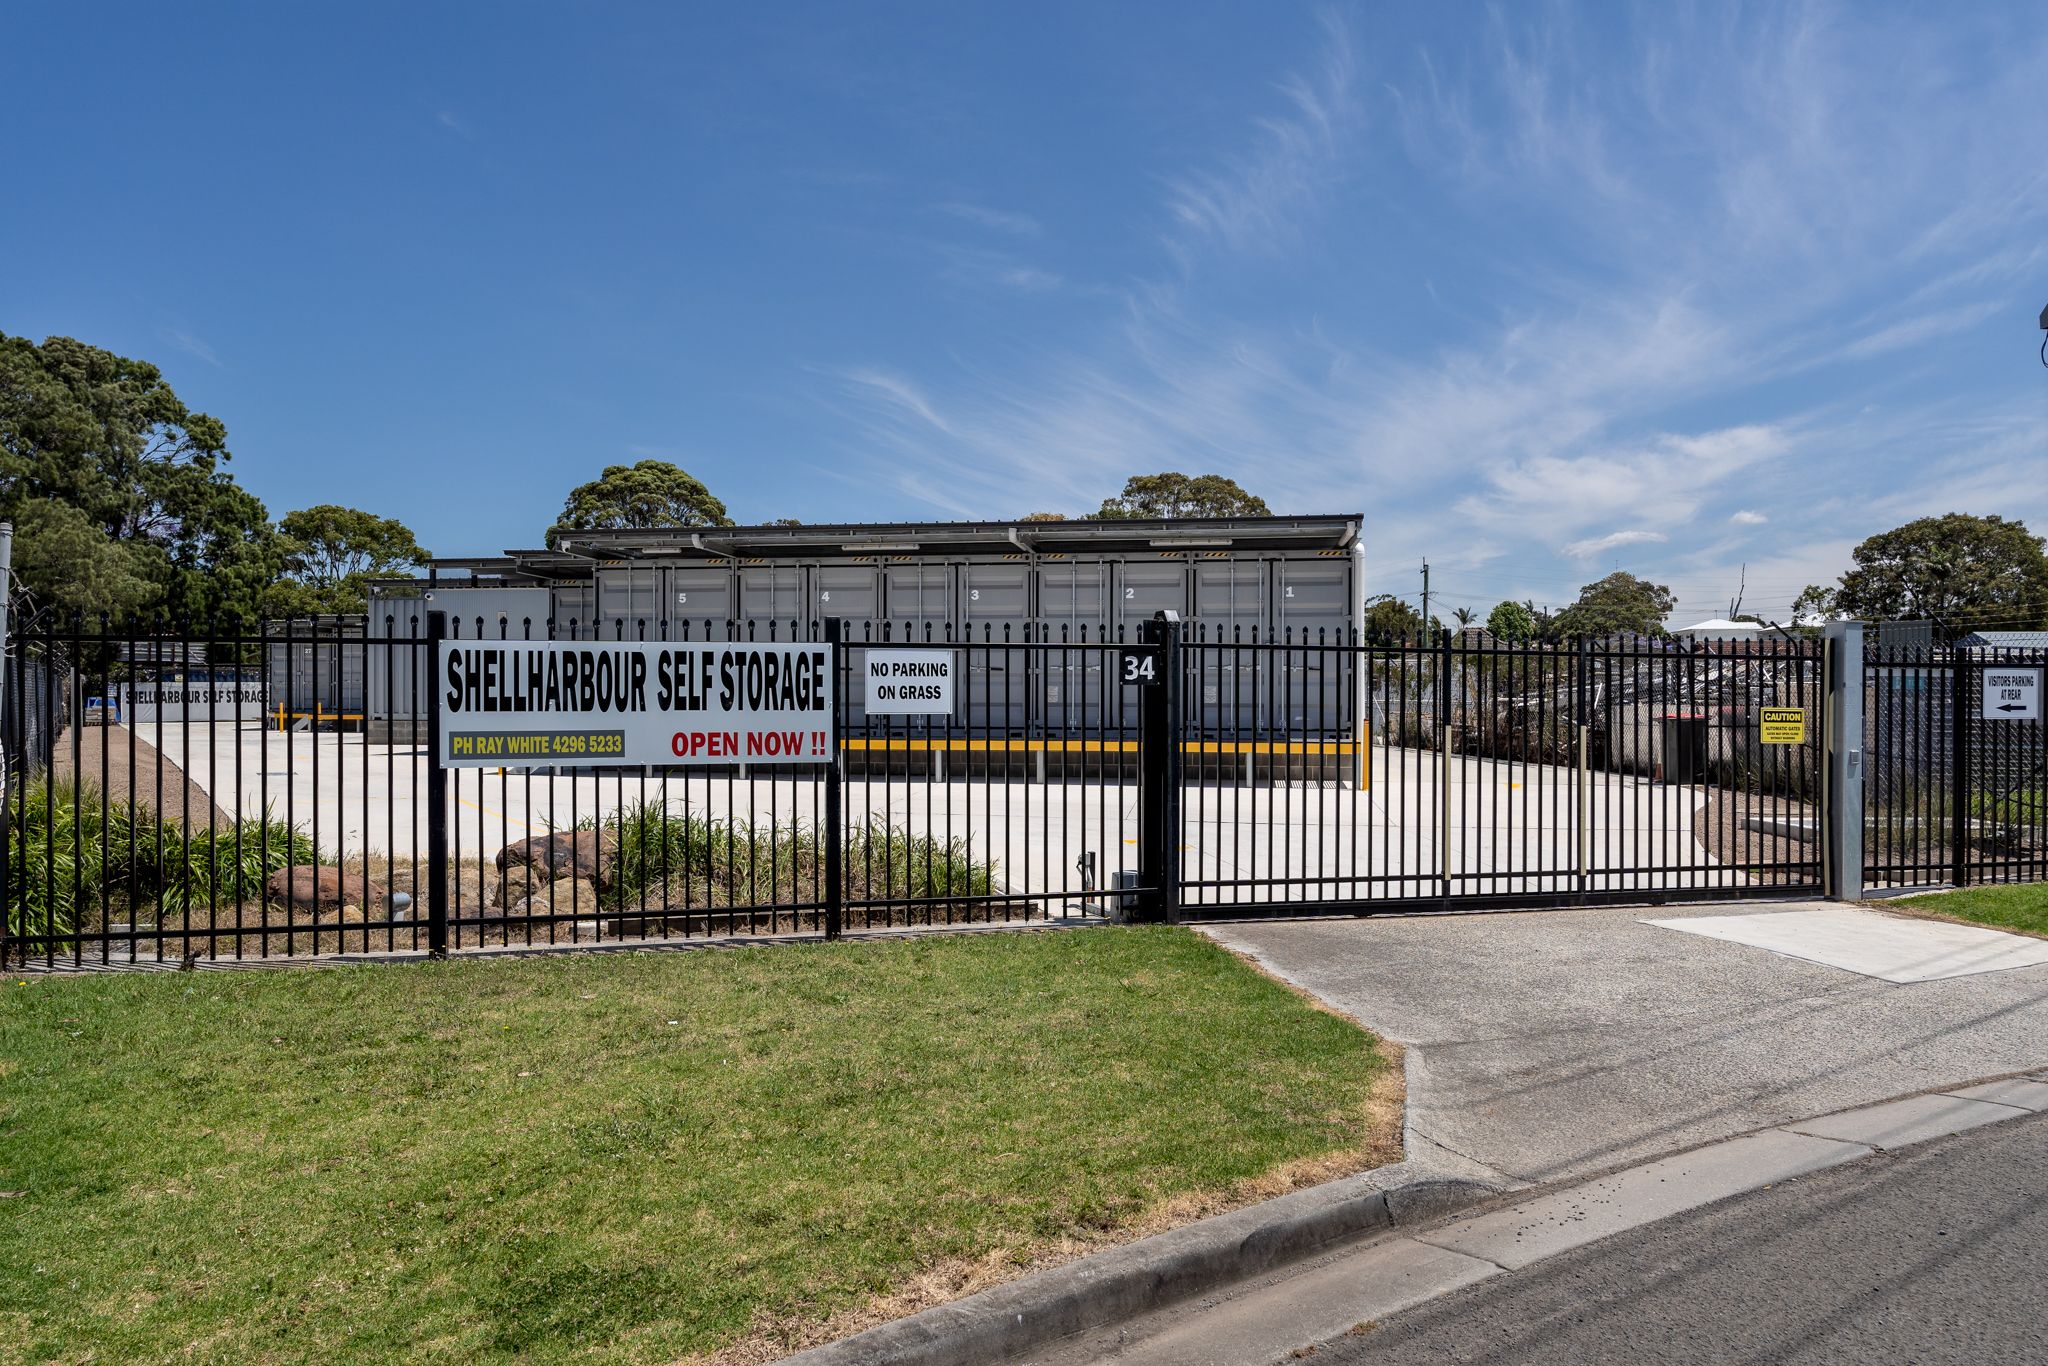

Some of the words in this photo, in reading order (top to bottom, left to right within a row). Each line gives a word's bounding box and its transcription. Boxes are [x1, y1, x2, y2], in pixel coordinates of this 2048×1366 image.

[821, 591, 830, 602] 4
[970, 589, 980, 601] 3
[1125, 587, 1135, 599] 2
[1285, 586, 1295, 598] 1
[678, 593, 687, 604] 5
[870, 662, 889, 677] NO
[892, 662, 948, 677] PARKING
[1124, 655, 1155, 681] 34
[446, 649, 647, 713] SHELLHARBOUR
[657, 650, 715, 712] SELF
[719, 650, 825, 712] STORAGE
[1987, 675, 2011, 687] VISITORS
[2011, 675, 2034, 687] PARKING
[202, 690, 224, 704] SLF
[877, 685, 896, 700] ON
[899, 685, 942, 700] GRASS
[2000, 689, 2007, 700] AT
[2007, 689, 2022, 700] REAR
[1764, 712, 1801, 722] CAUTION
[453, 737, 473, 754] PH
[476, 737, 503, 754] RAY
[507, 736, 549, 754] WHITE
[553, 735, 585, 753] 4296
[589, 735, 622, 753] 5233
[671, 731, 739, 757] OPEN
[747, 731, 804, 756] NOW
[811, 731, 826, 756] !!
